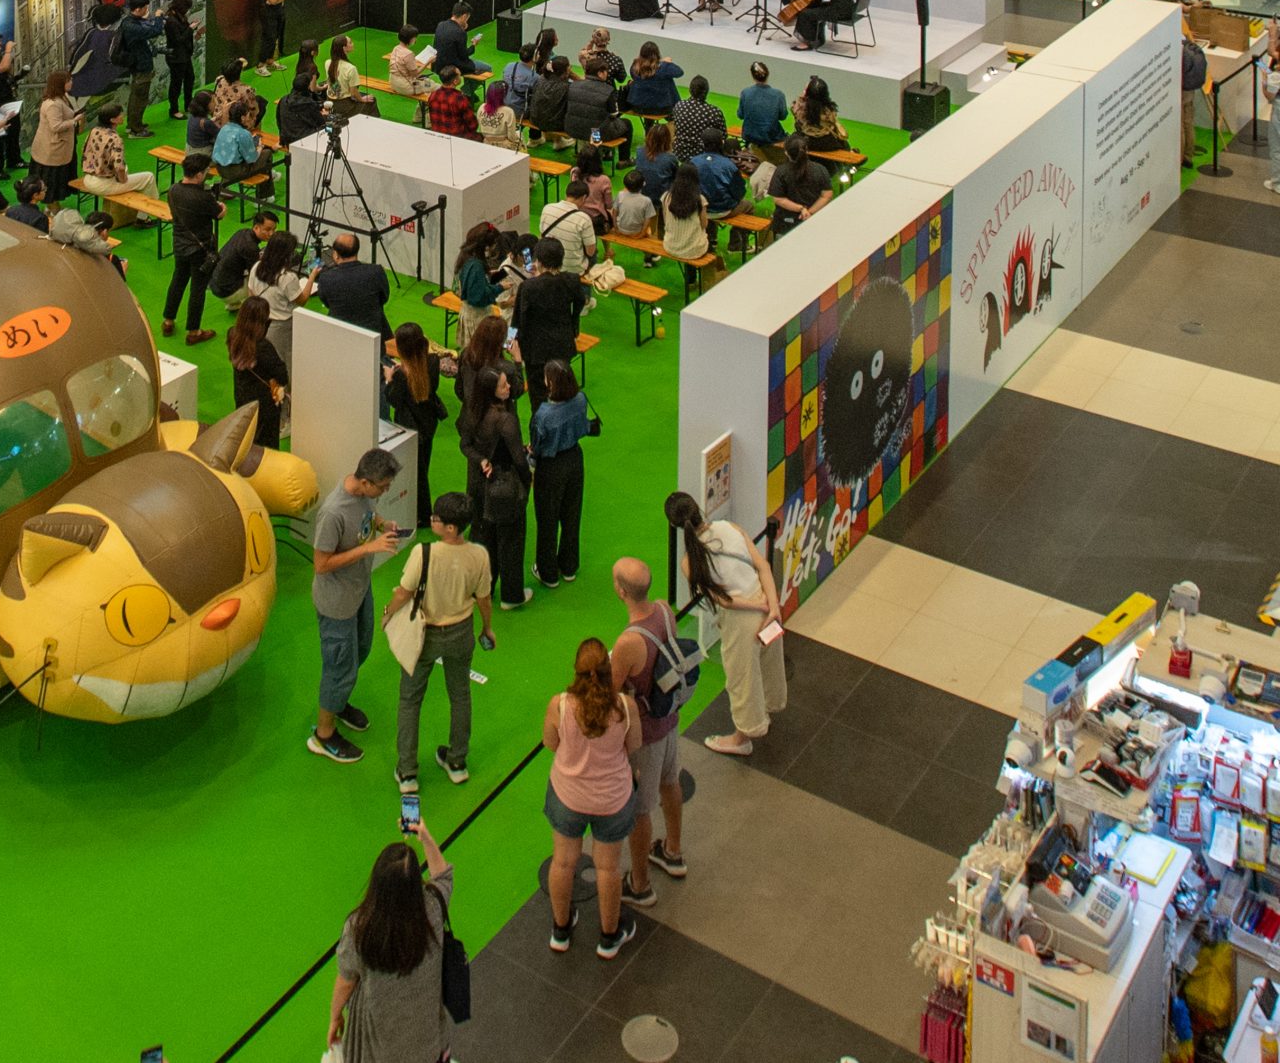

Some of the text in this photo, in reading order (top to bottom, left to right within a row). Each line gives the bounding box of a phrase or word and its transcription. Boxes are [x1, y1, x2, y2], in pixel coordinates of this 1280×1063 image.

[959, 162, 1076, 305] SPIRITED AWAY
[1, 313, 59, 349] めい
[825, 477, 862, 556] Go!
